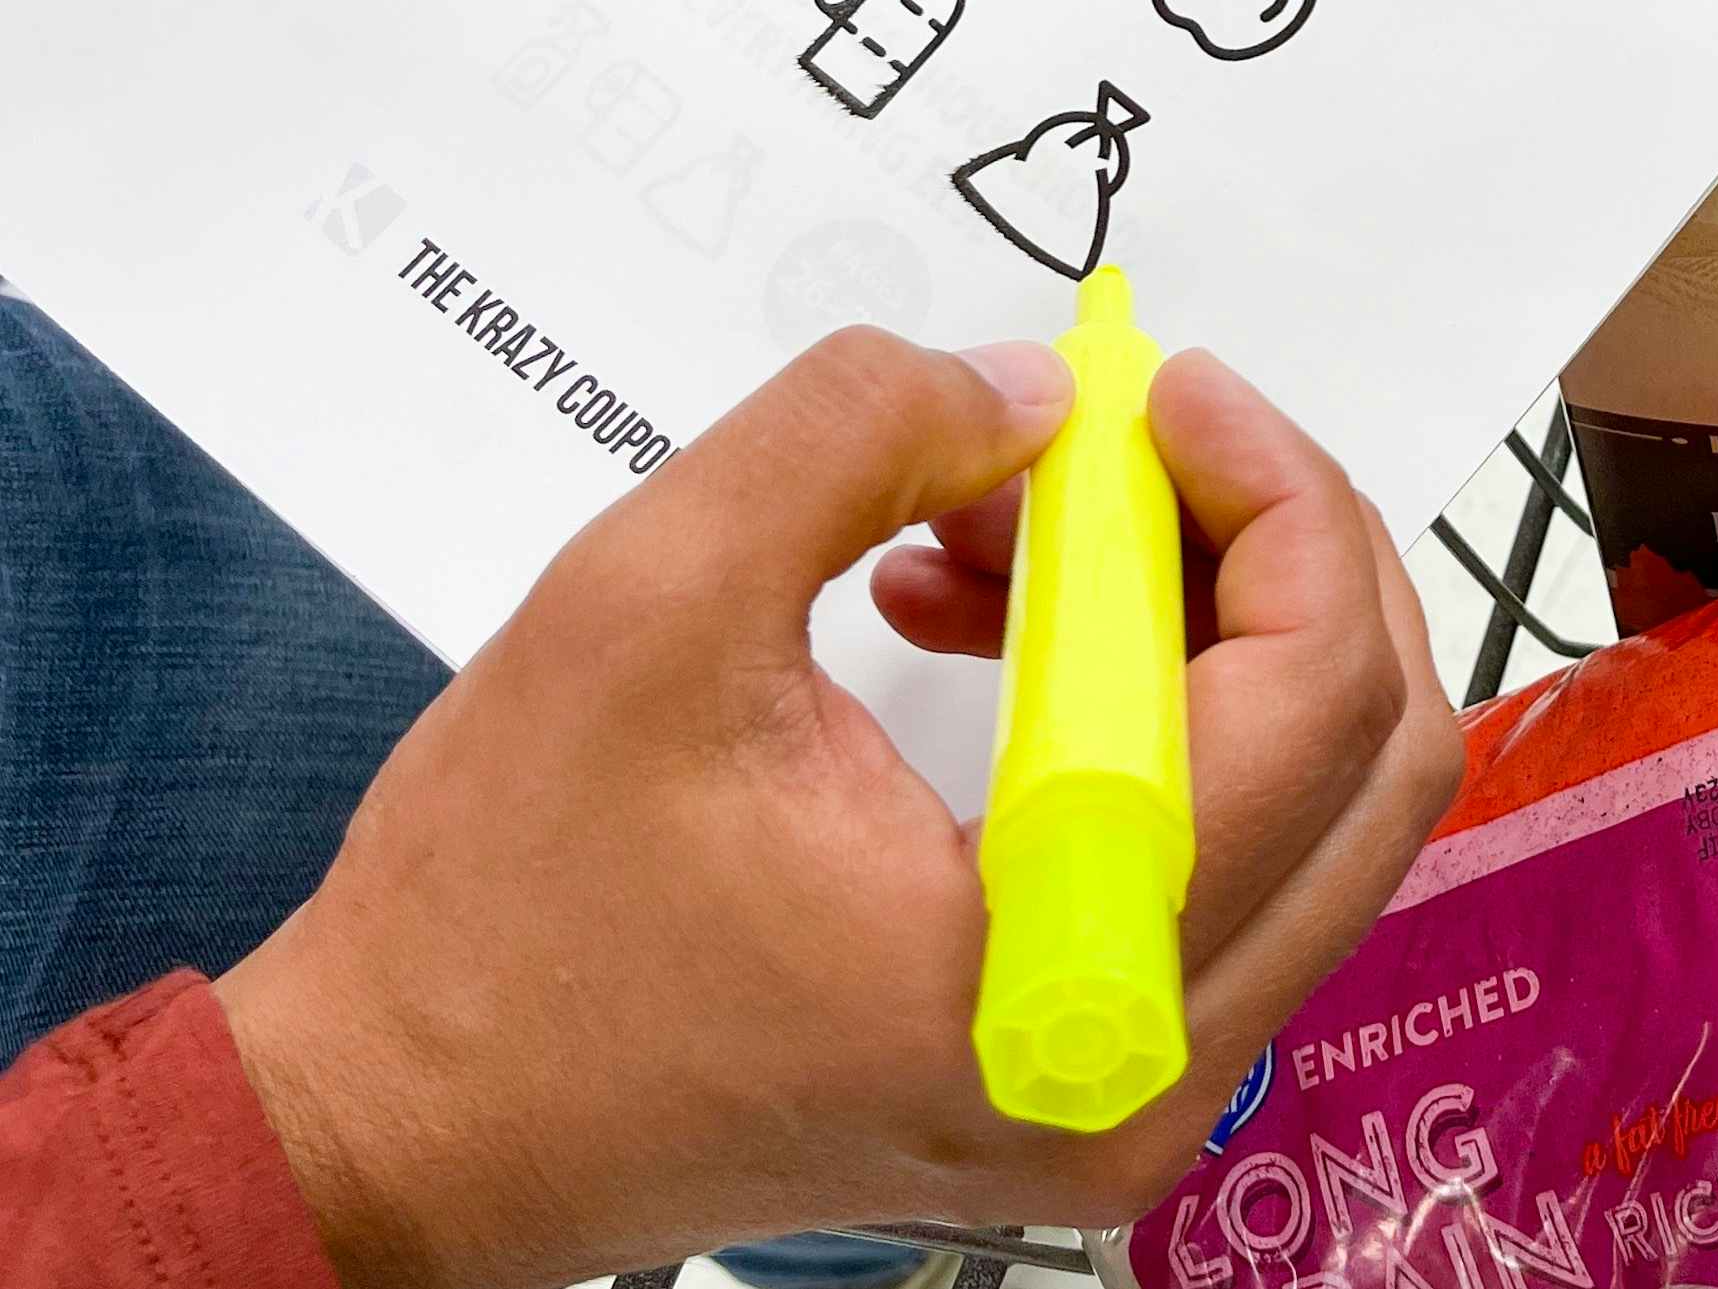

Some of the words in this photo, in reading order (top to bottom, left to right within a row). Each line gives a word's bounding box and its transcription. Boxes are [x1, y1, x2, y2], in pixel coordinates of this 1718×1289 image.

[398, 237, 478, 314] THE
[454, 289, 578, 393] KRAZY
[556, 374, 680, 477] COUPO
[1293, 966, 1542, 1091] ENRICHED
[1168, 1083, 1499, 1289] LONG
[1583, 1143, 1608, 1176] a
[1612, 1107, 1666, 1177] fat
